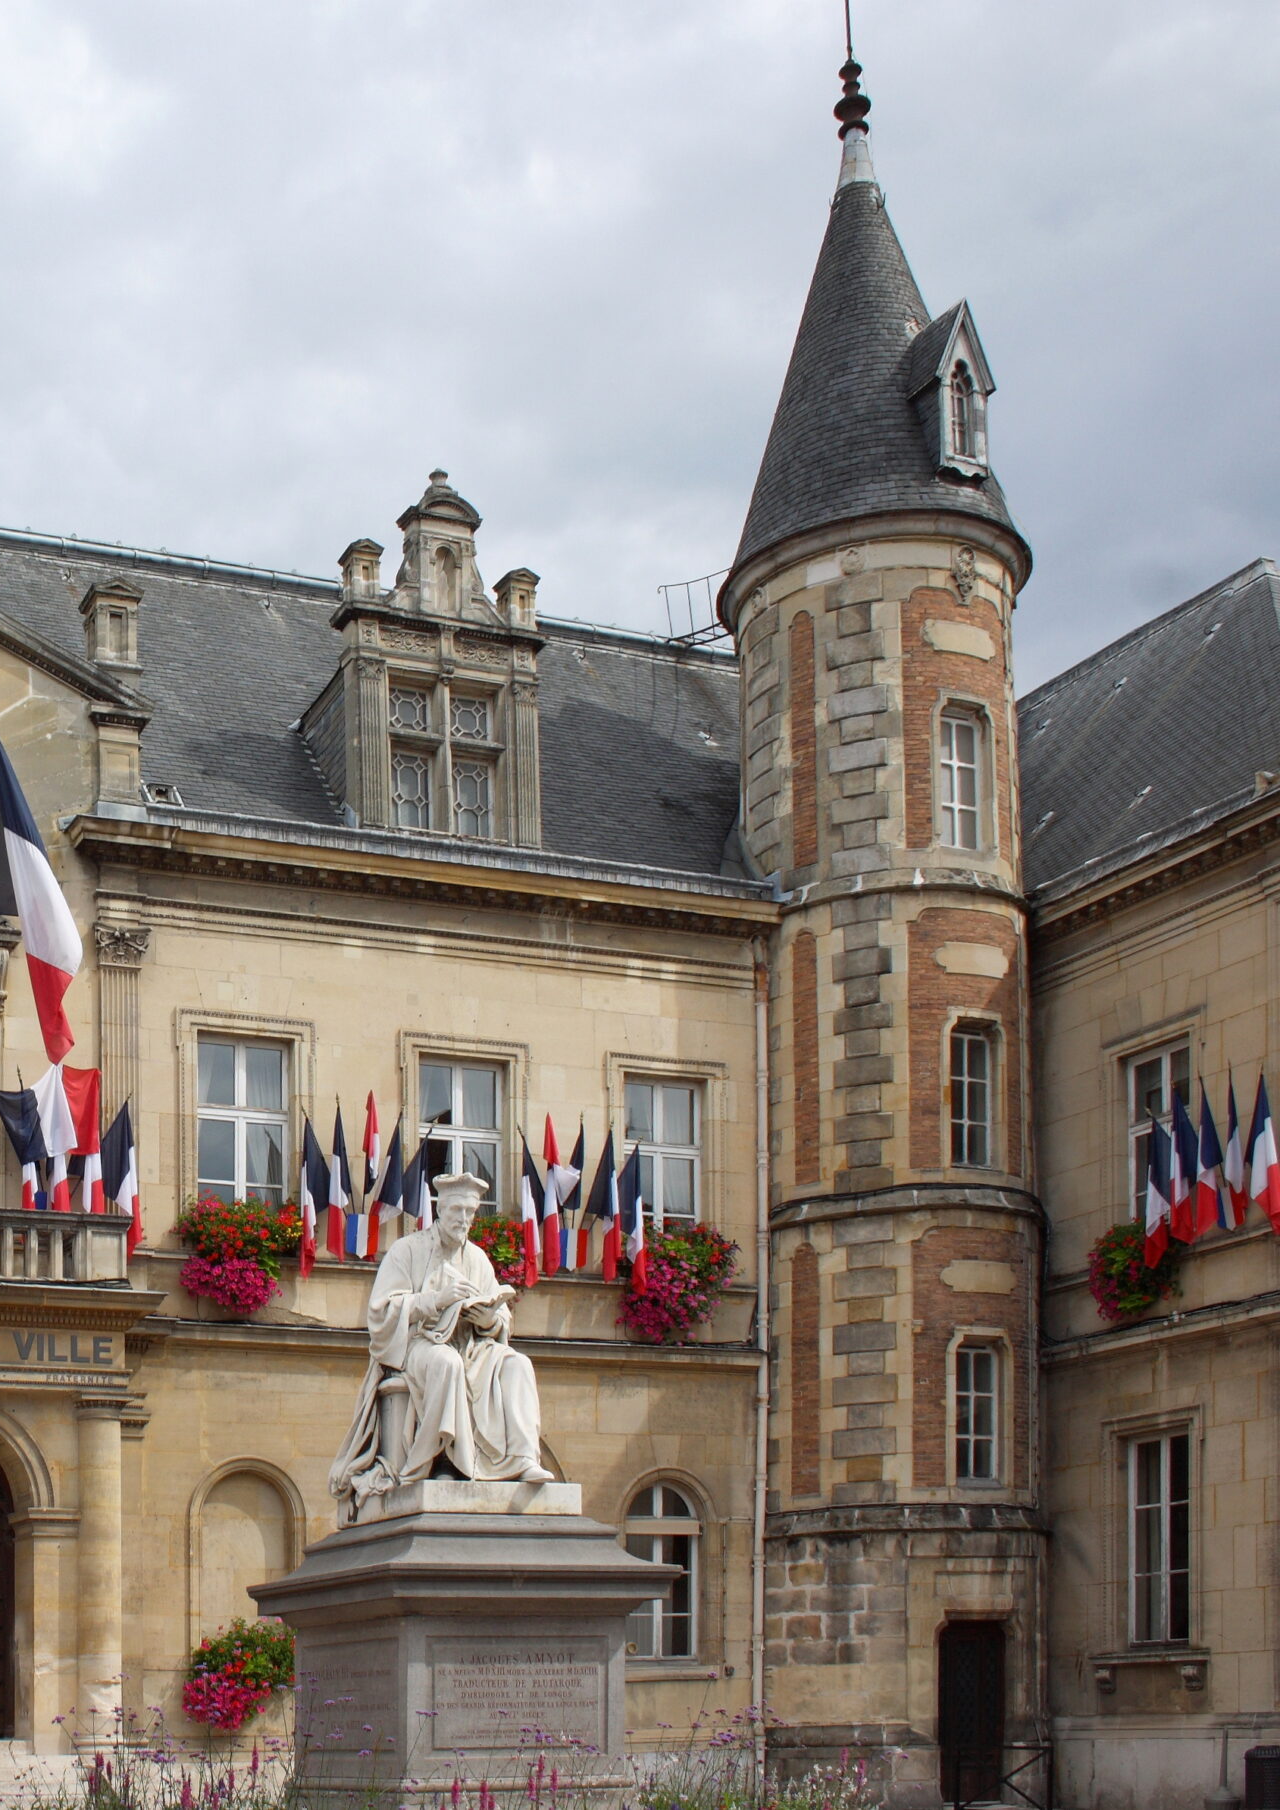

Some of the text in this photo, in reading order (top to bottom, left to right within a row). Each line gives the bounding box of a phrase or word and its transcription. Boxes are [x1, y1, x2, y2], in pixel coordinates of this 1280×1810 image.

[13, 1331, 114, 1365] VILLE
[471, 1654, 518, 1667] JACQUES
[526, 1652, 575, 1665] AMYOT
[453, 1678, 583, 1690] TRADUCTEUR DE PLUTARQUE
